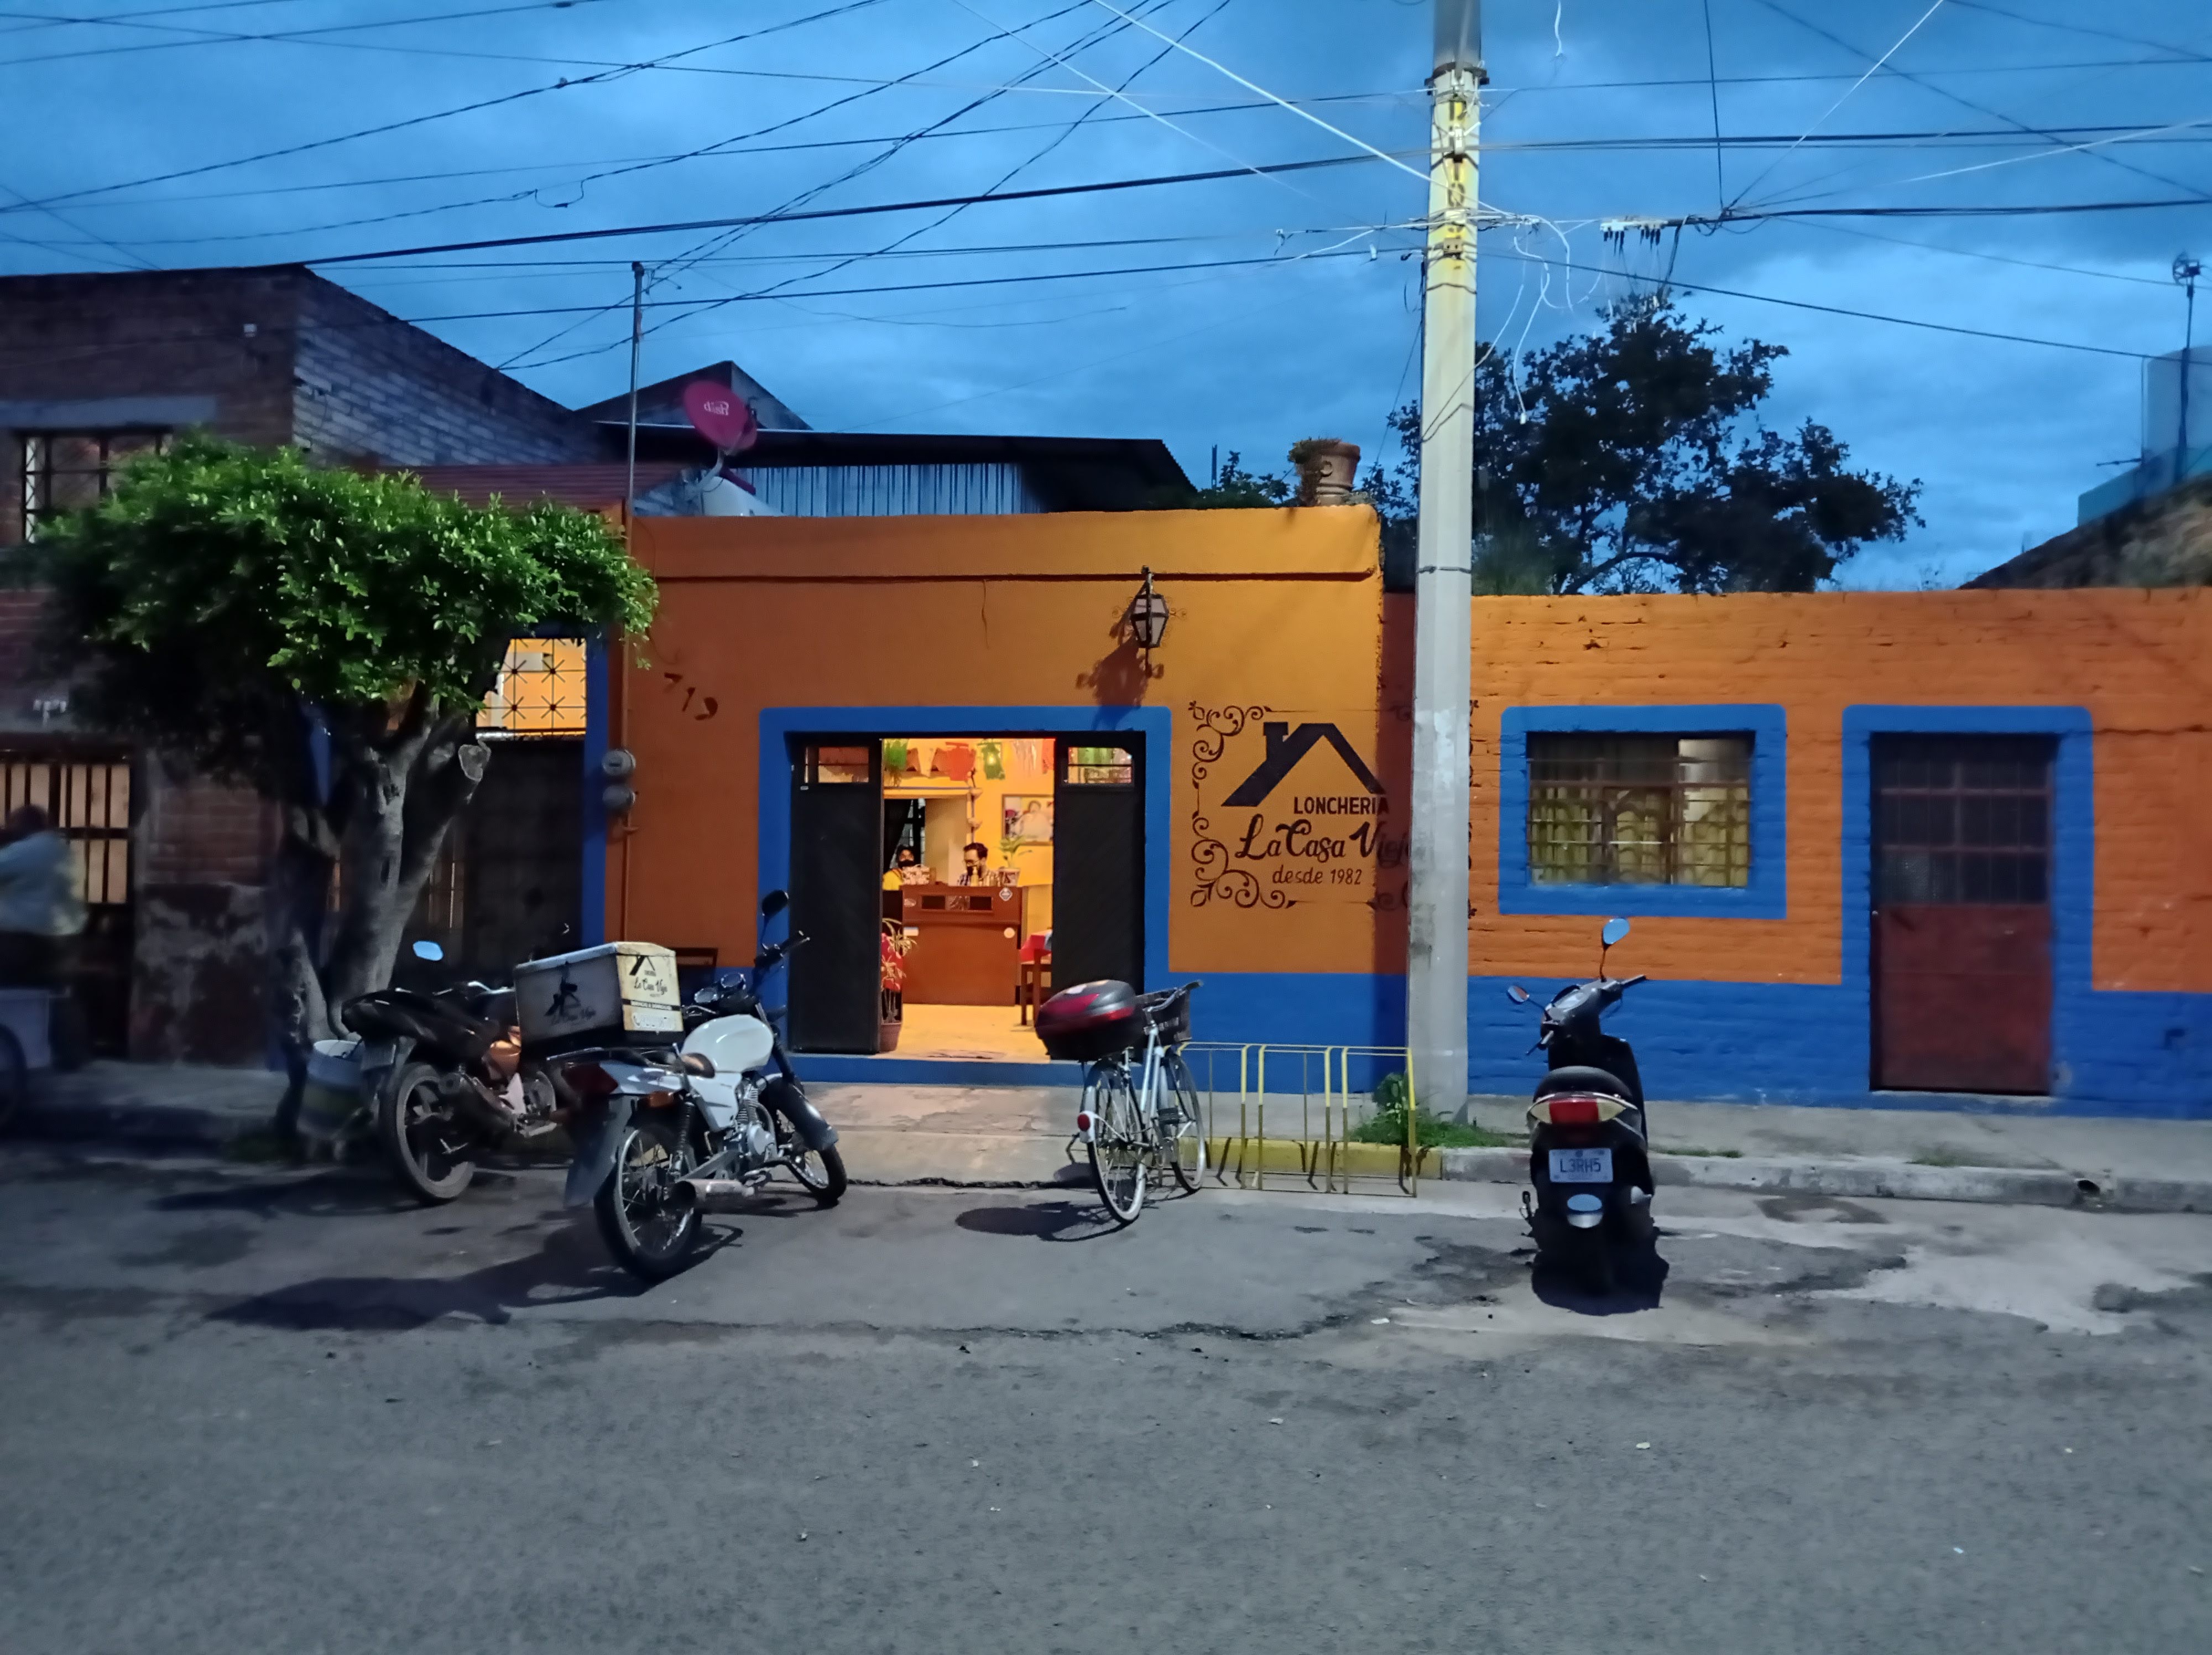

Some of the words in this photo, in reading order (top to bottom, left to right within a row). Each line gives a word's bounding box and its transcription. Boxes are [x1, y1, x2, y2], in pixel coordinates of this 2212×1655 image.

[1293, 797, 1390, 815] LONCHERIA
[1235, 814, 1282, 860] La
[1275, 819, 1346, 863] Casa
[1272, 865, 1323, 885] desde
[1330, 868, 1363, 885] 1982
